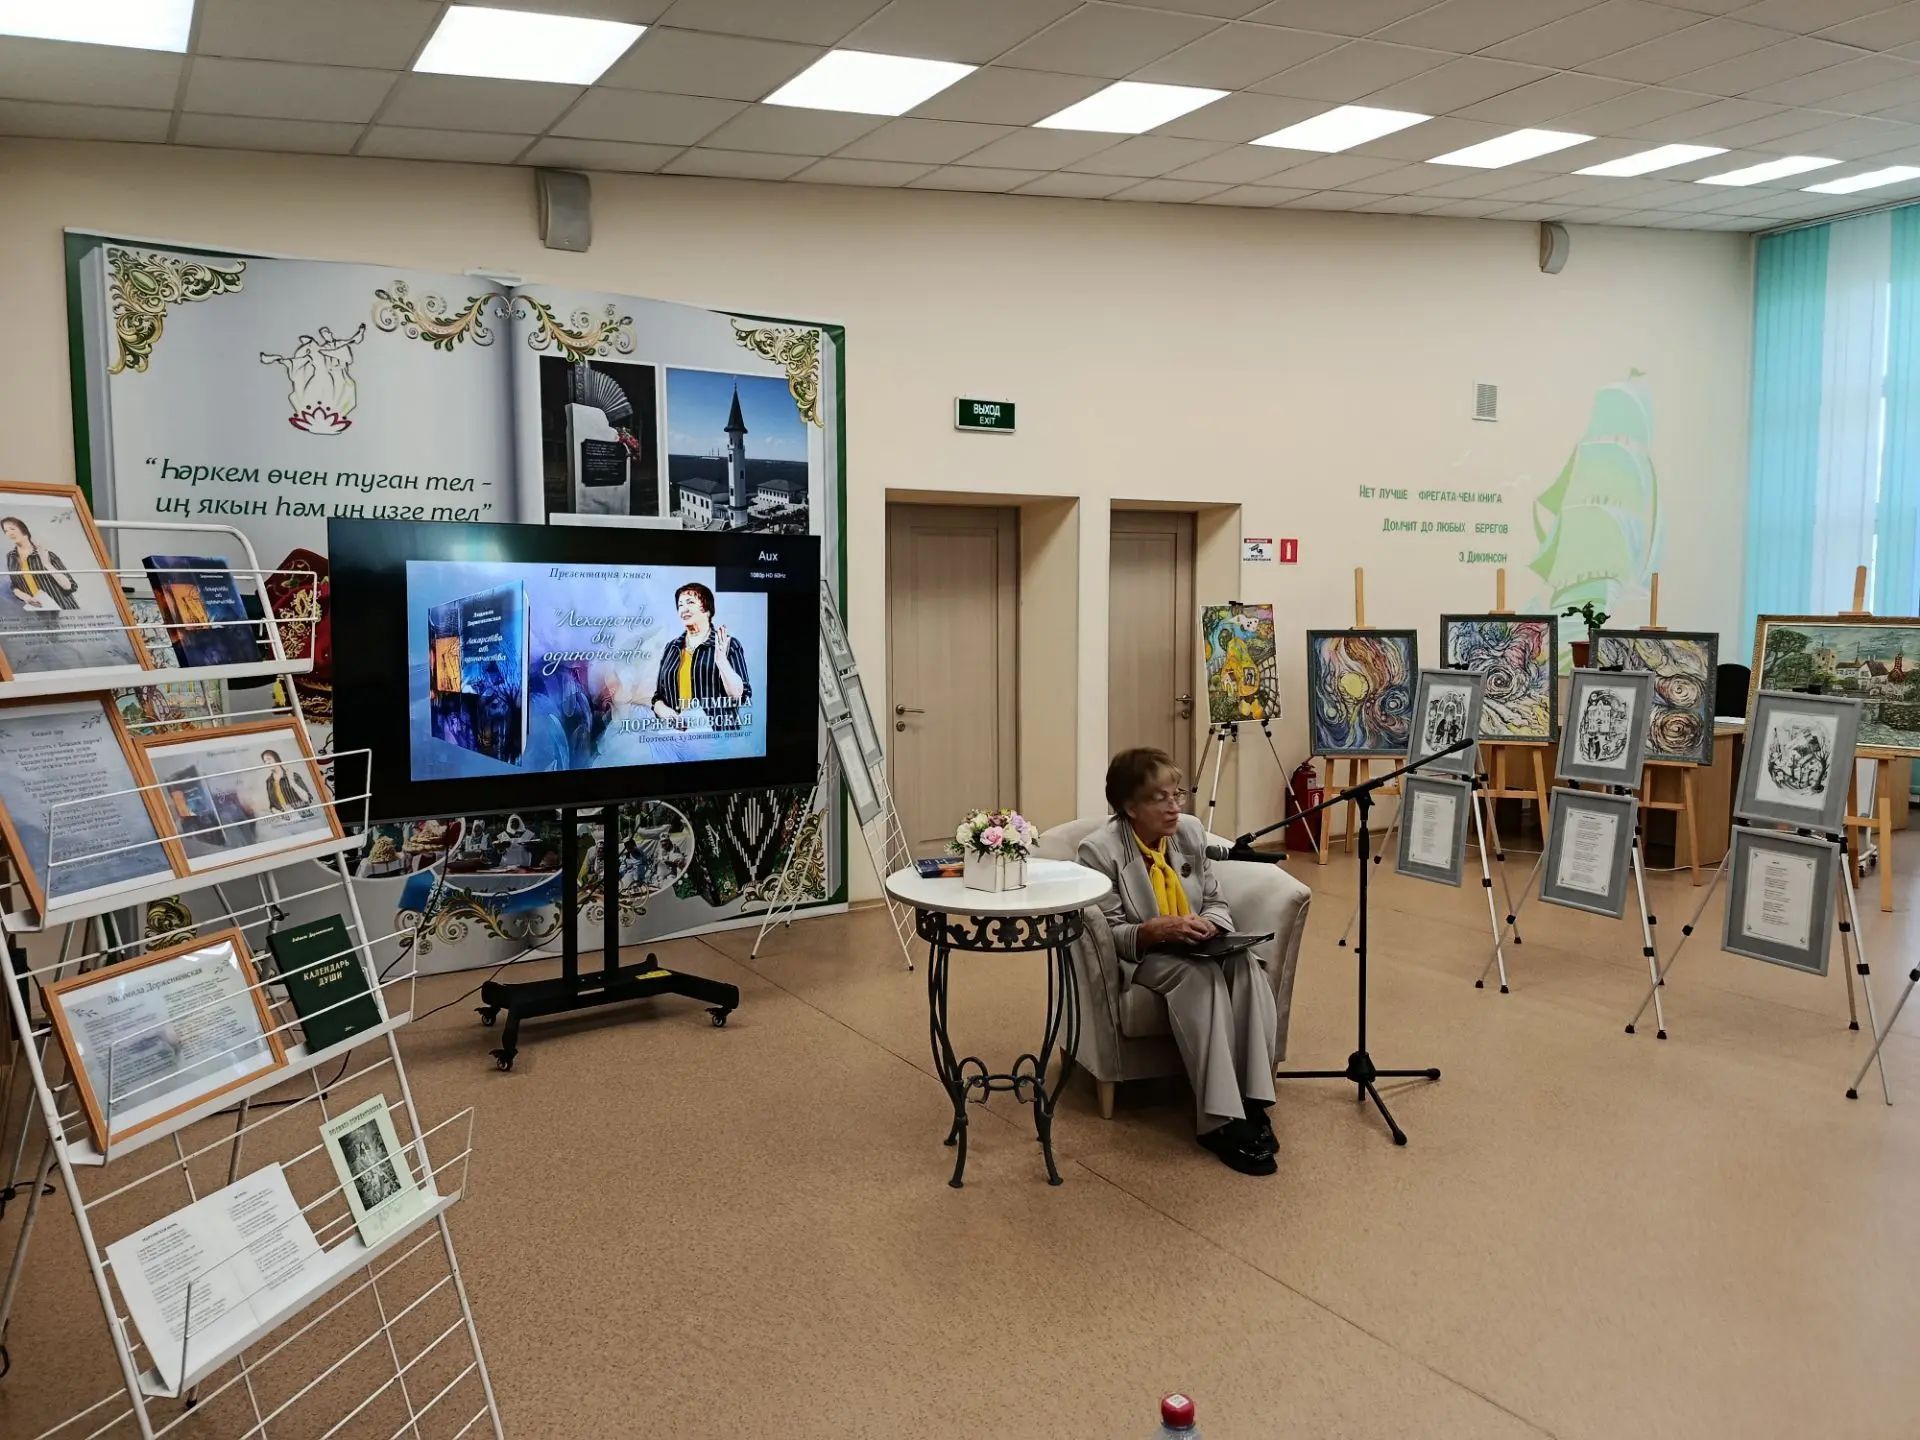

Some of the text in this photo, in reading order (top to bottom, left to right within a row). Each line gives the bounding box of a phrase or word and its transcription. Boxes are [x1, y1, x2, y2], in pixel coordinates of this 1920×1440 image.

[973, 403, 1001, 417] ВЫХОД
[980, 416, 996, 424] EXIT
[267, 469, 328, 486] өчен
[336, 472, 418, 493] туган
[426, 475, 475, 492] тел
[1379, 488, 1408, 499] ЛУЧШЕ
[1478, 492, 1503, 503] КНИГА
[156, 497, 190, 518] иң
[197, 498, 267, 515] якын
[275, 496, 325, 517] һәм
[372, 504, 424, 520] изге
[1421, 521, 1433, 532] ДО
[1436, 521, 1465, 532] ЛЮБЫХ
[1475, 523, 1508, 534] БЕРЕГОВ
[759, 550, 778, 561] Aux
[549, 567, 651, 580] Презентация книги
[591, 631, 615, 648] от
[676, 697, 752, 710] ЛЮДМИЛА
[619, 714, 752, 734] ДОРЖЕНКОВСКАЯ
[303, 960, 350, 980] КАЛЕНДАРЬ
[318, 971, 343, 986] ДУШИ
